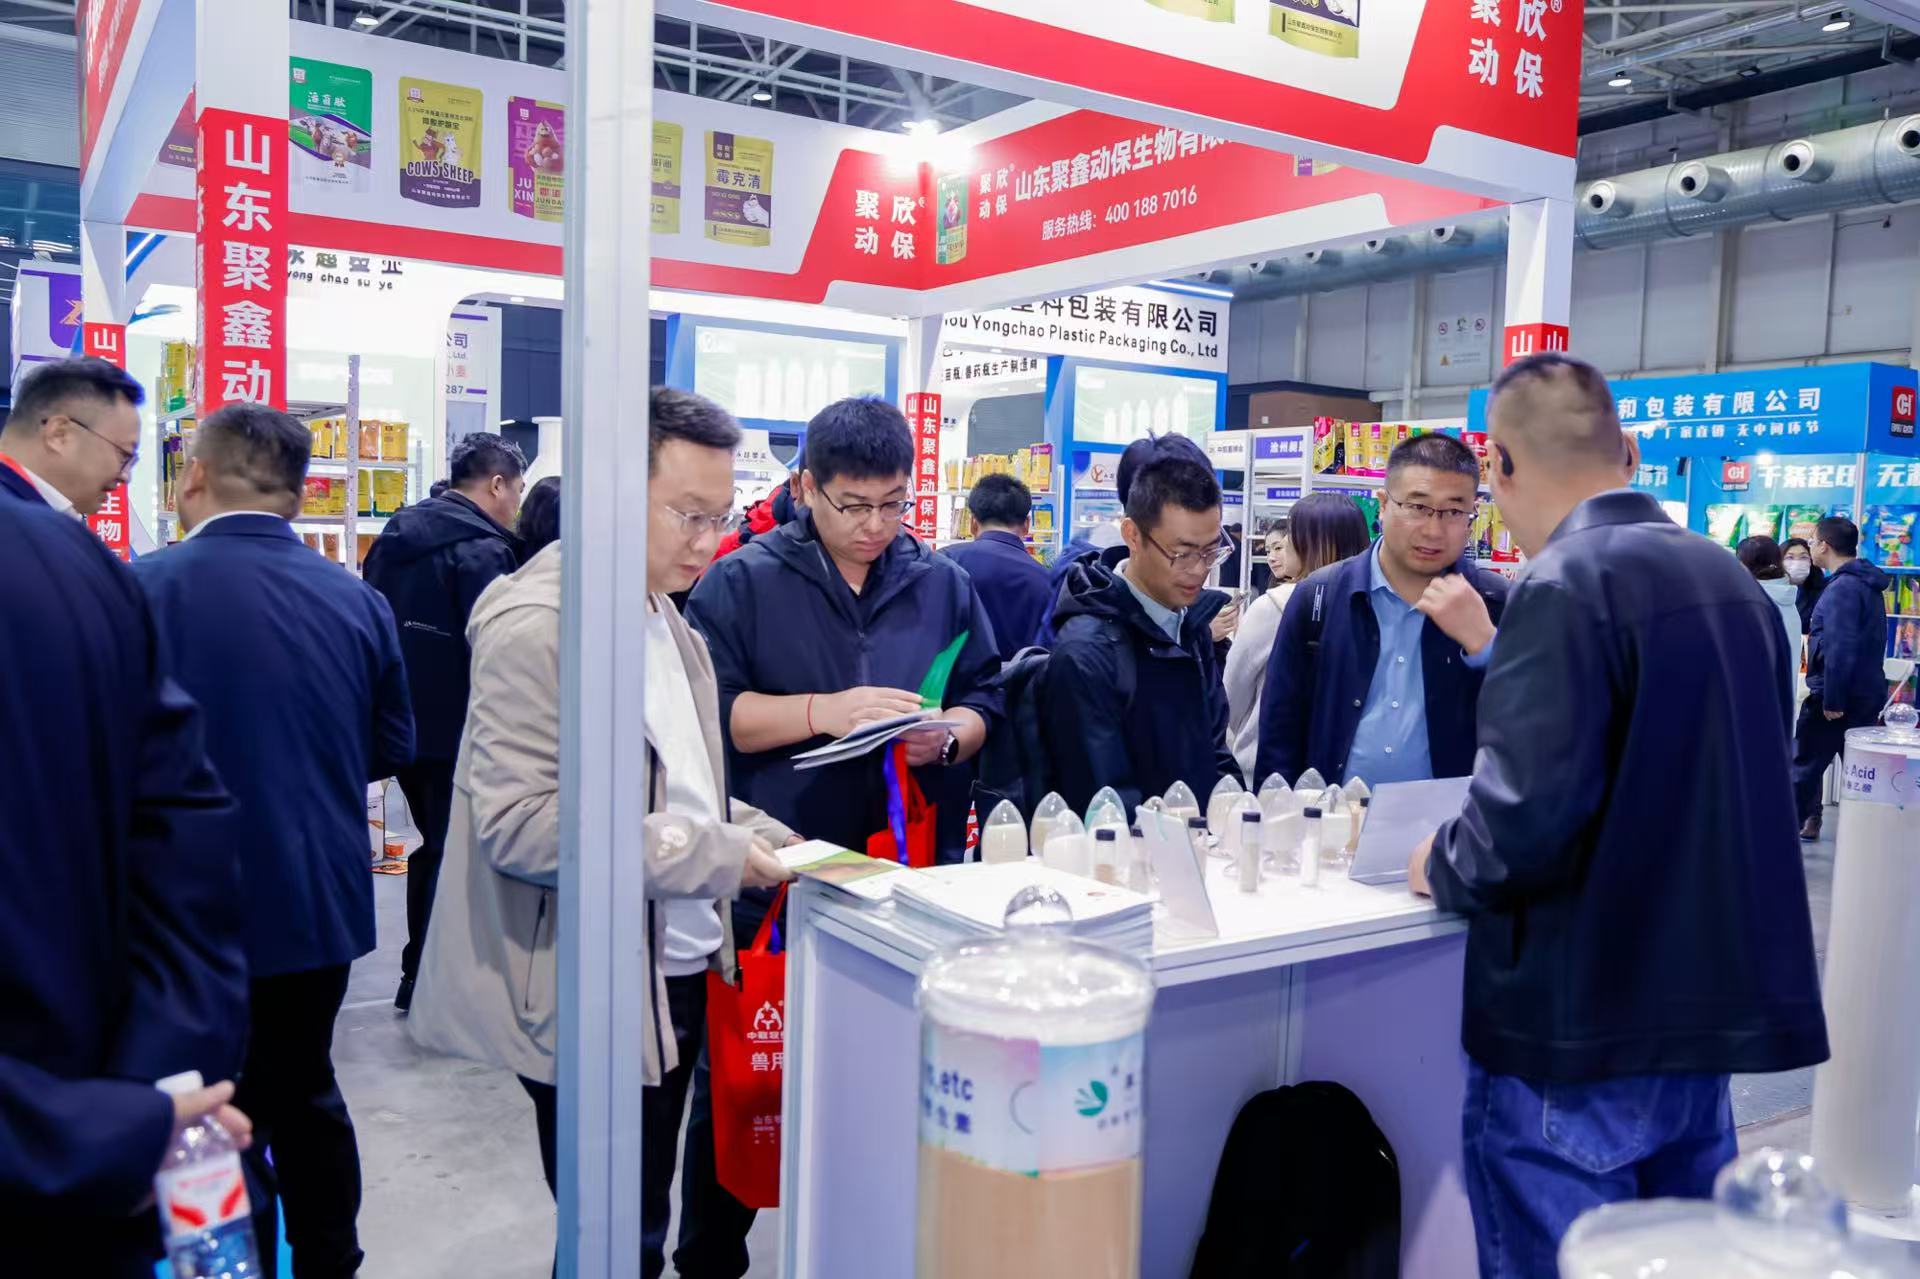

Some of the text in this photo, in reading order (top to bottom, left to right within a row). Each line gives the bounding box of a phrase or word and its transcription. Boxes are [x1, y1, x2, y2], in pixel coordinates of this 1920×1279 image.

[1468, 38, 1543, 98] 动保
[1015, 126, 1231, 202] 山东聚鑫动保生物有
[855, 190, 917, 225] 聚欣
[1105, 201, 1130, 225] 400
[1134, 194, 1158, 218] 188
[1162, 184, 1198, 212] 7016
[855, 226, 916, 260] 动保
[222, 123, 273, 406] 山东聚鑫动
[321, 273, 349, 285] chao
[357, 278, 371, 287] su
[379, 281, 393, 291] ye
[972, 314, 1045, 338] Yongchao
[1050, 324, 1096, 344] Plastic
[1099, 332, 1167, 355] Packaging
[1170, 339, 1194, 357] Co.,
[1198, 345, 1218, 358] Ltd
[1512, 329, 1533, 357] 山
[1851, 763, 1876, 780] Acid
